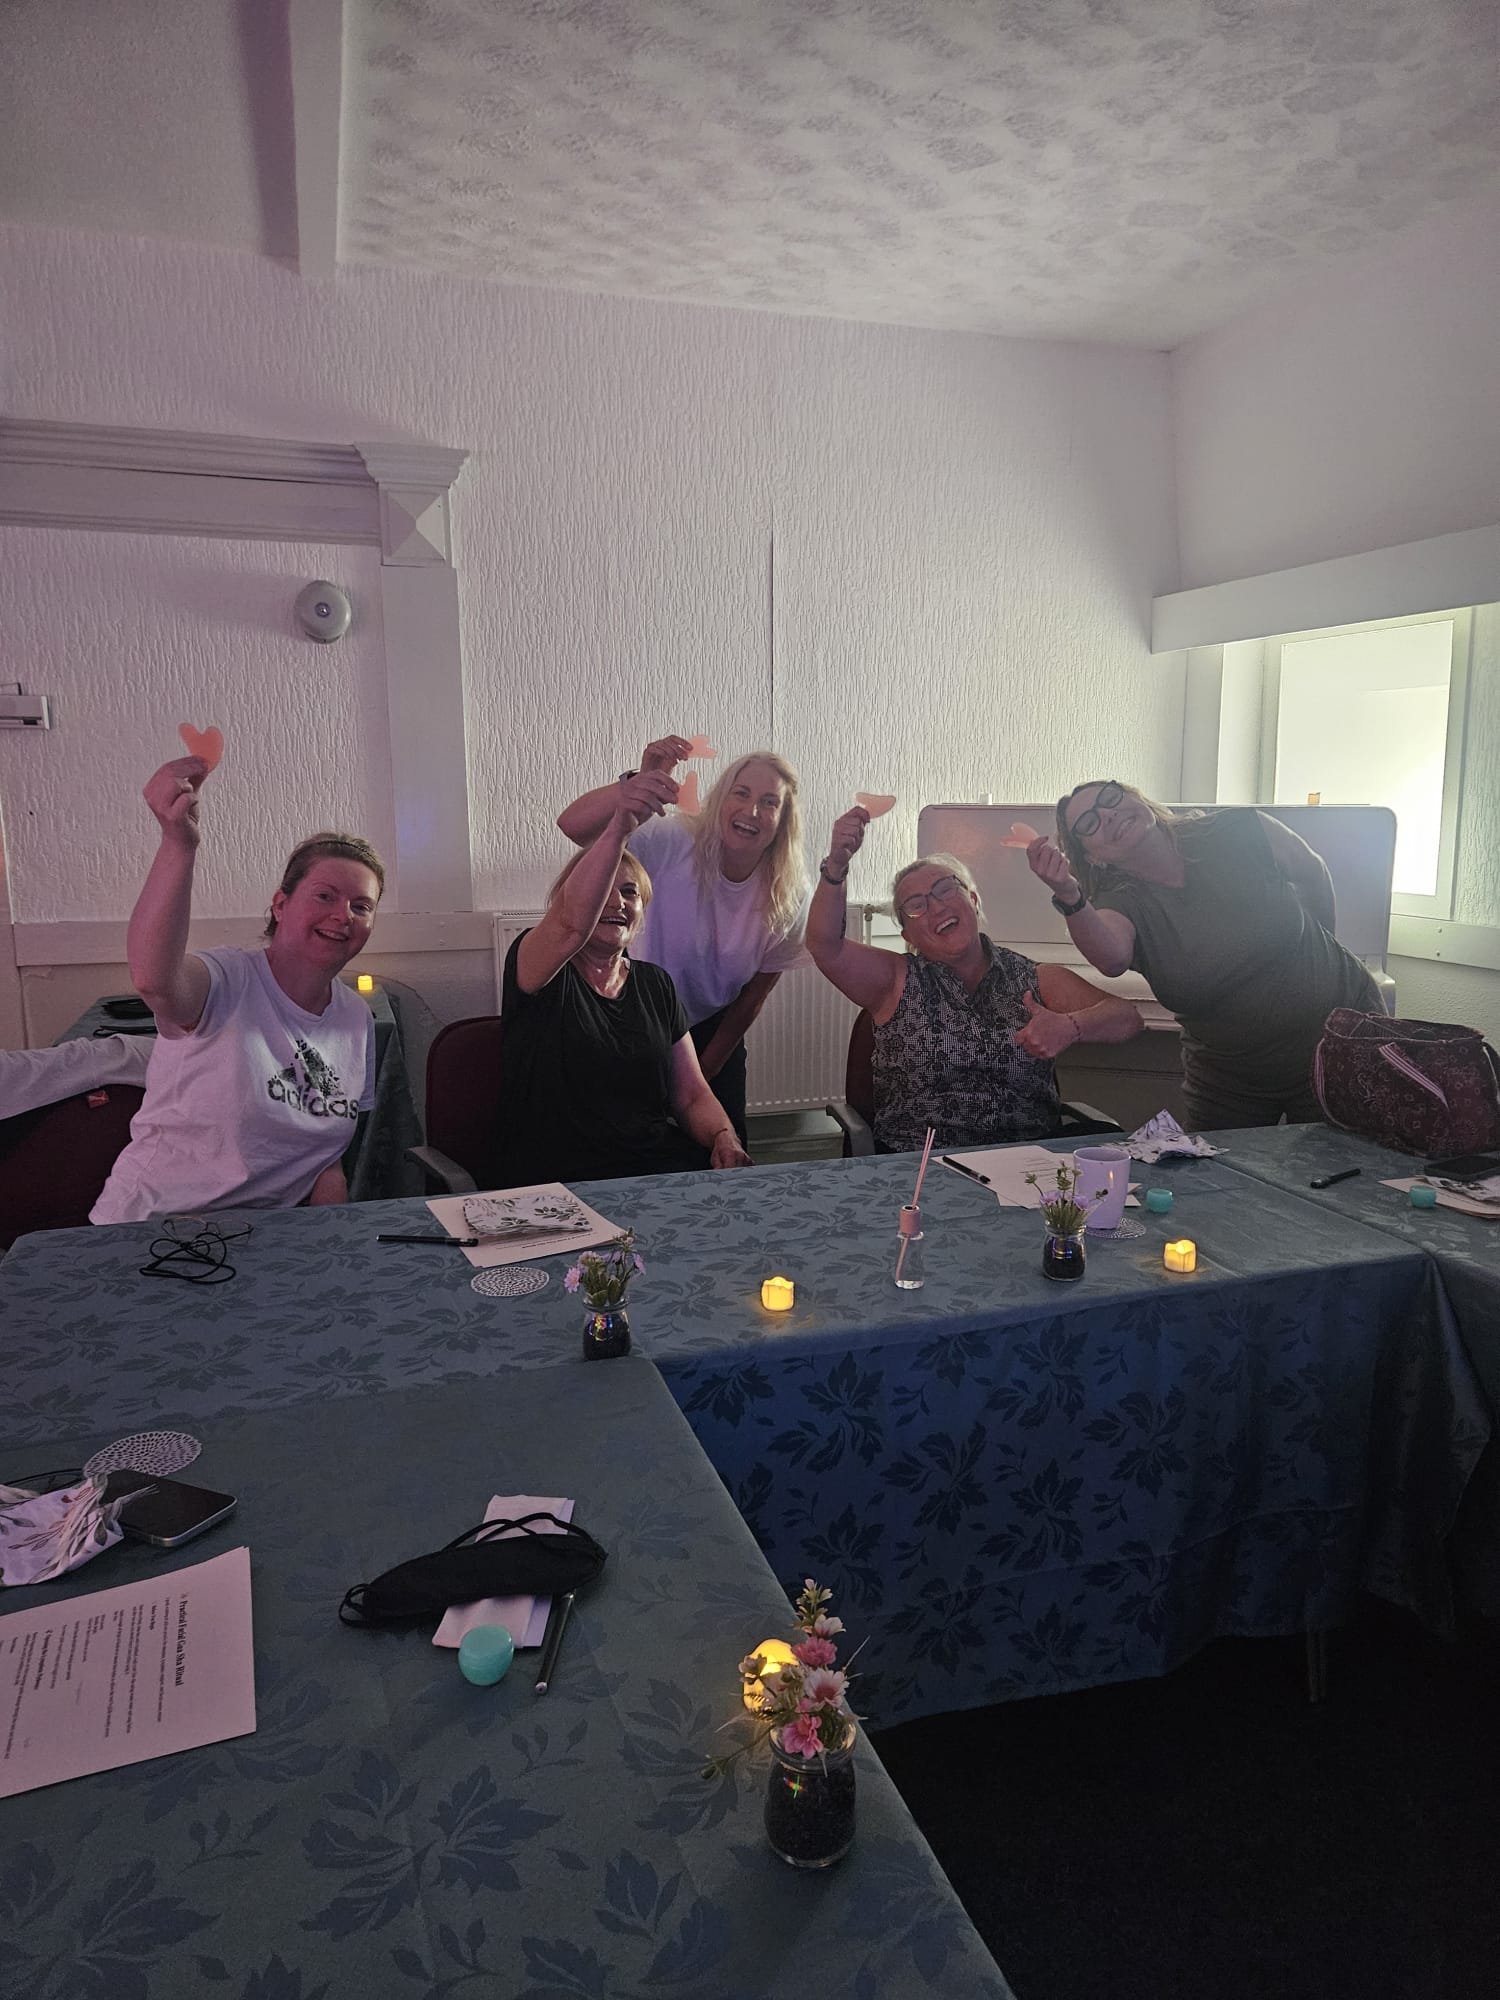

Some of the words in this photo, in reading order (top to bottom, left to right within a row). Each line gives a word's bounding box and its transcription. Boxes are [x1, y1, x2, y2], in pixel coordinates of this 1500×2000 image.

[268, 1079, 359, 1120] adidas
[176, 1653, 185, 1666] Sha
[175, 1665, 185, 1687] Ritual
